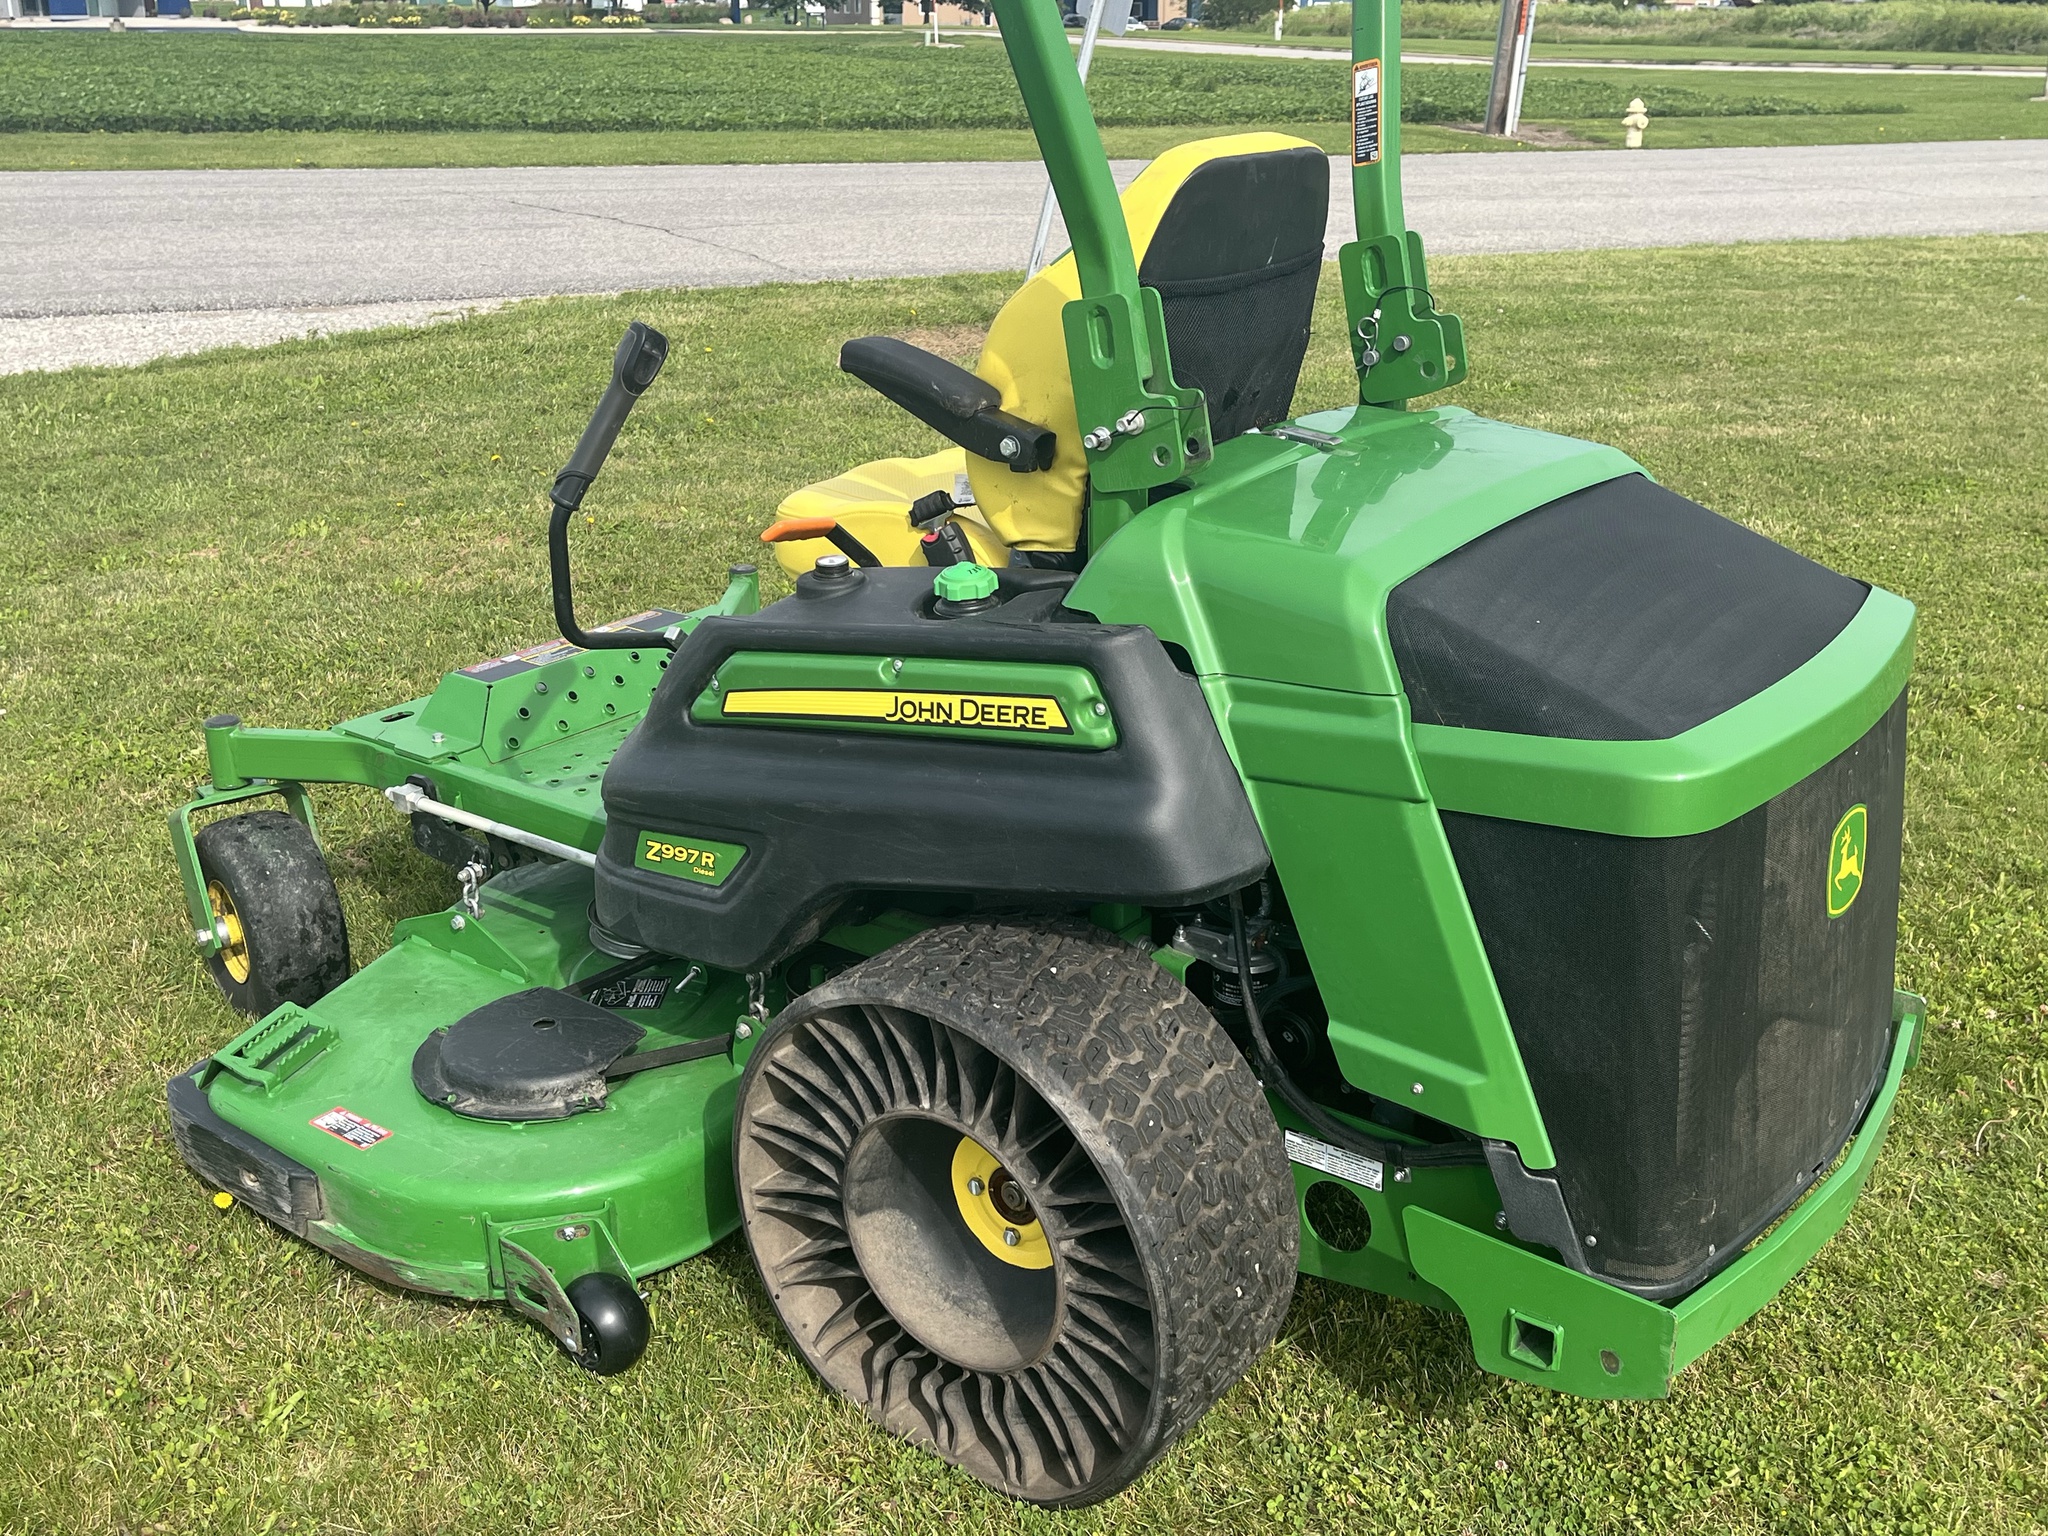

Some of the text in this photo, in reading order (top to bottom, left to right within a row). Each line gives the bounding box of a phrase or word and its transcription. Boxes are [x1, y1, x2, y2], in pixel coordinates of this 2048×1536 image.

[886, 696, 1047, 726] JOHN DEERE
[692, 866, 715, 877] Diesel
